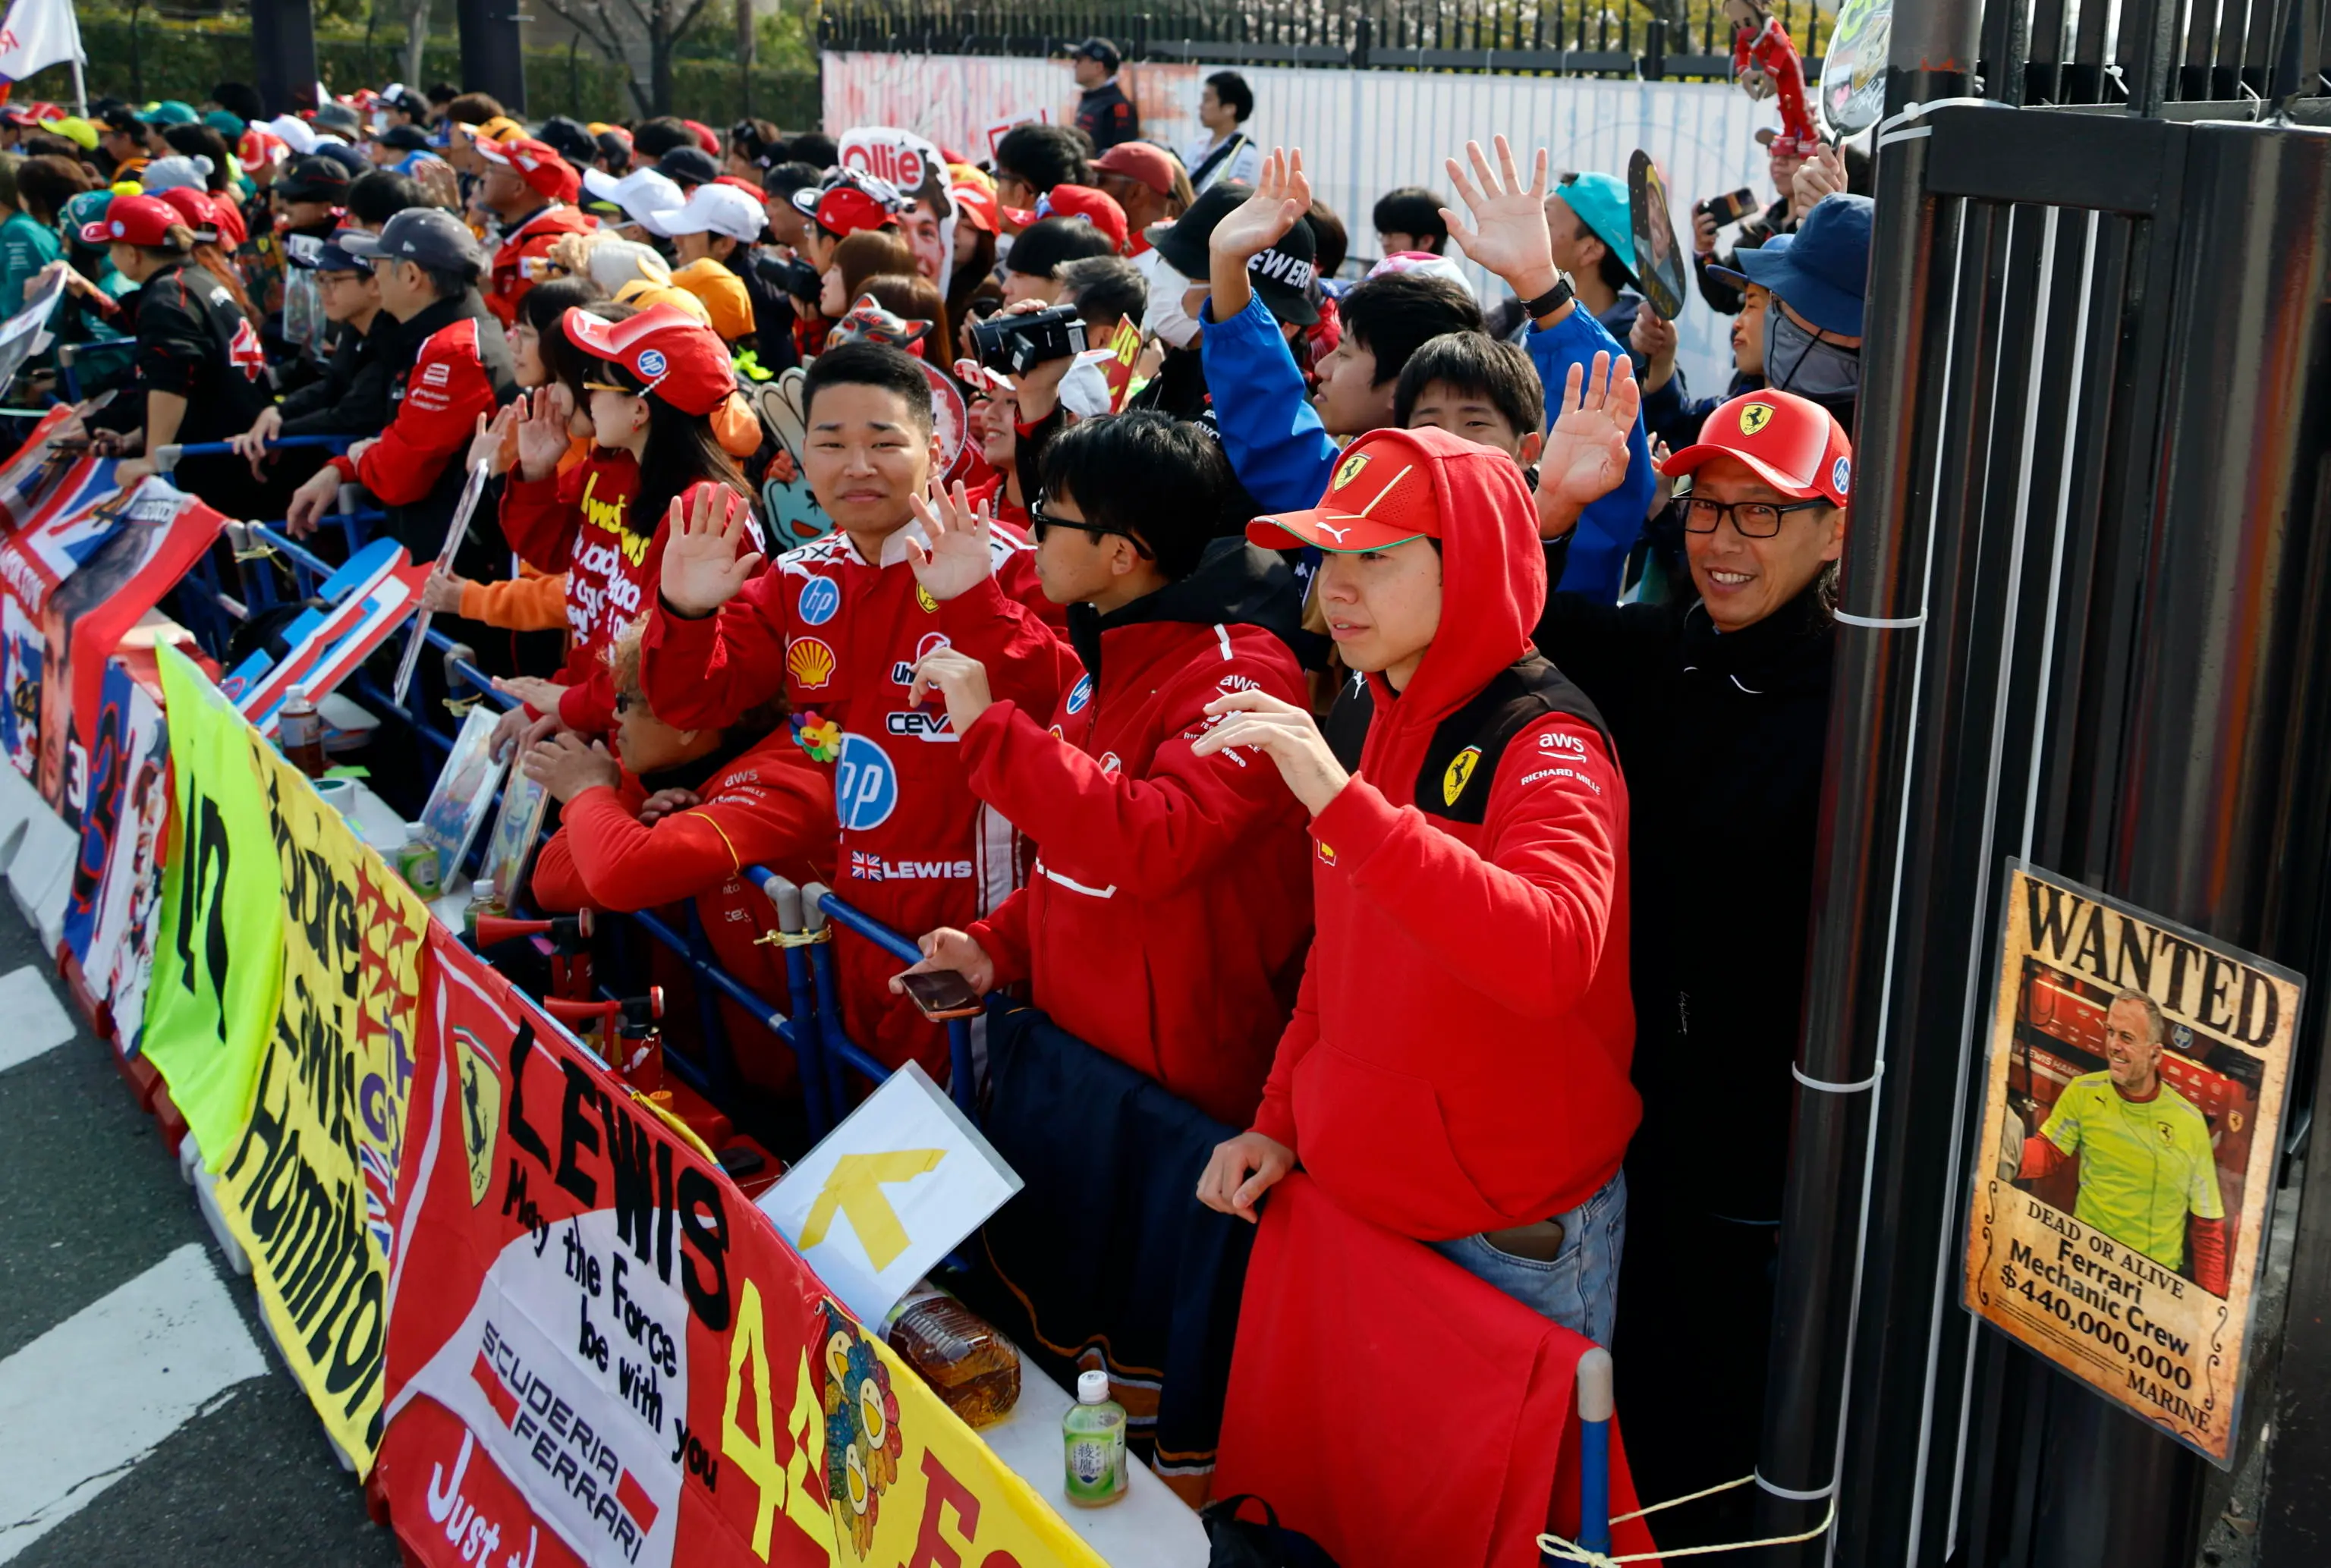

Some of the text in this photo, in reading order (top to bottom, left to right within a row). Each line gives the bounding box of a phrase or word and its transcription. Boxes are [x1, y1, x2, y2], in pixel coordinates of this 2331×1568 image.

[843, 144, 920, 185] Ollie
[1248, 248, 1294, 279] EW
[1220, 674, 1260, 692] aws
[725, 768, 758, 787] aws
[1521, 768, 1602, 796] RICHARD MILLE
[1539, 733, 1584, 753] aws
[882, 861, 973, 879] LEWIS
[2024, 875, 2279, 1048] WANTED
[508, 1014, 731, 1332] LEWIS
[502, 1158, 677, 1378] May the Force
[2010, 1237, 2121, 1321] Mechanic
[2126, 1305, 2191, 1357] Crew
[2027, 1201, 2185, 1300] DEAD OR ALIVE
[2056, 1237, 2143, 1306] Ferrari
[2001, 1263, 2193, 1391] $440,000,000
[482, 1318, 619, 1485] SCUDERIA
[579, 1294, 718, 1494] be with you
[721, 1277, 832, 1568] 44
[2125, 1368, 2212, 1434] MARINE
[426, 1428, 501, 1568] Just
[513, 1410, 643, 1566] FERRARI
